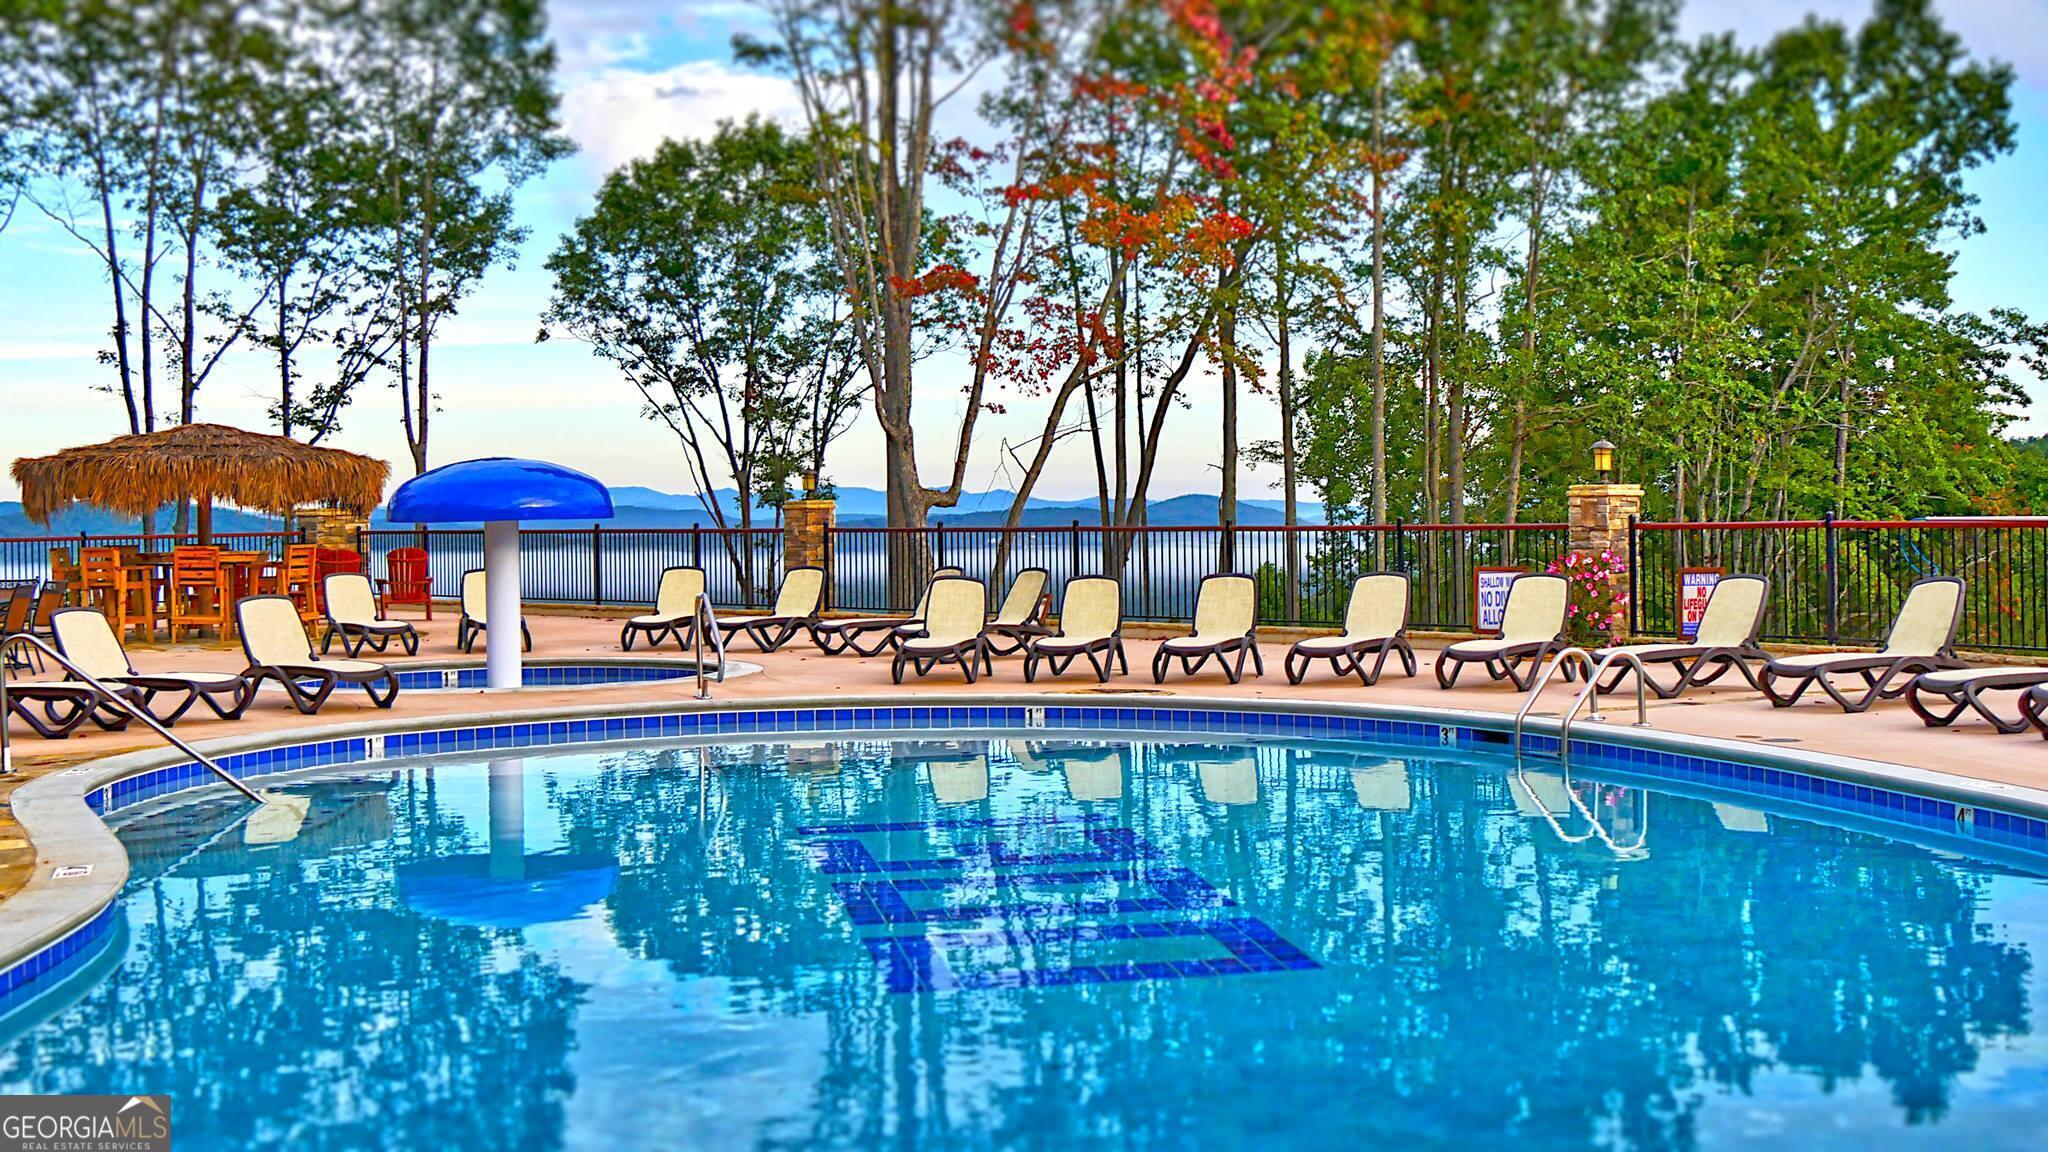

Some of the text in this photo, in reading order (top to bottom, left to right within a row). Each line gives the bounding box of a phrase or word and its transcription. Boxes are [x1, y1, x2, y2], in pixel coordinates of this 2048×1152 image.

[1481, 577, 1504, 588] SHALLOW
[1684, 574, 1720, 585] WARNING
[1697, 587, 1706, 597] NO
[1481, 591, 1506, 607] NO DIV
[1683, 599, 1708, 610] LIFEGU
[1483, 609, 1504, 625] ALLO
[1687, 611, 1697, 622] ON
